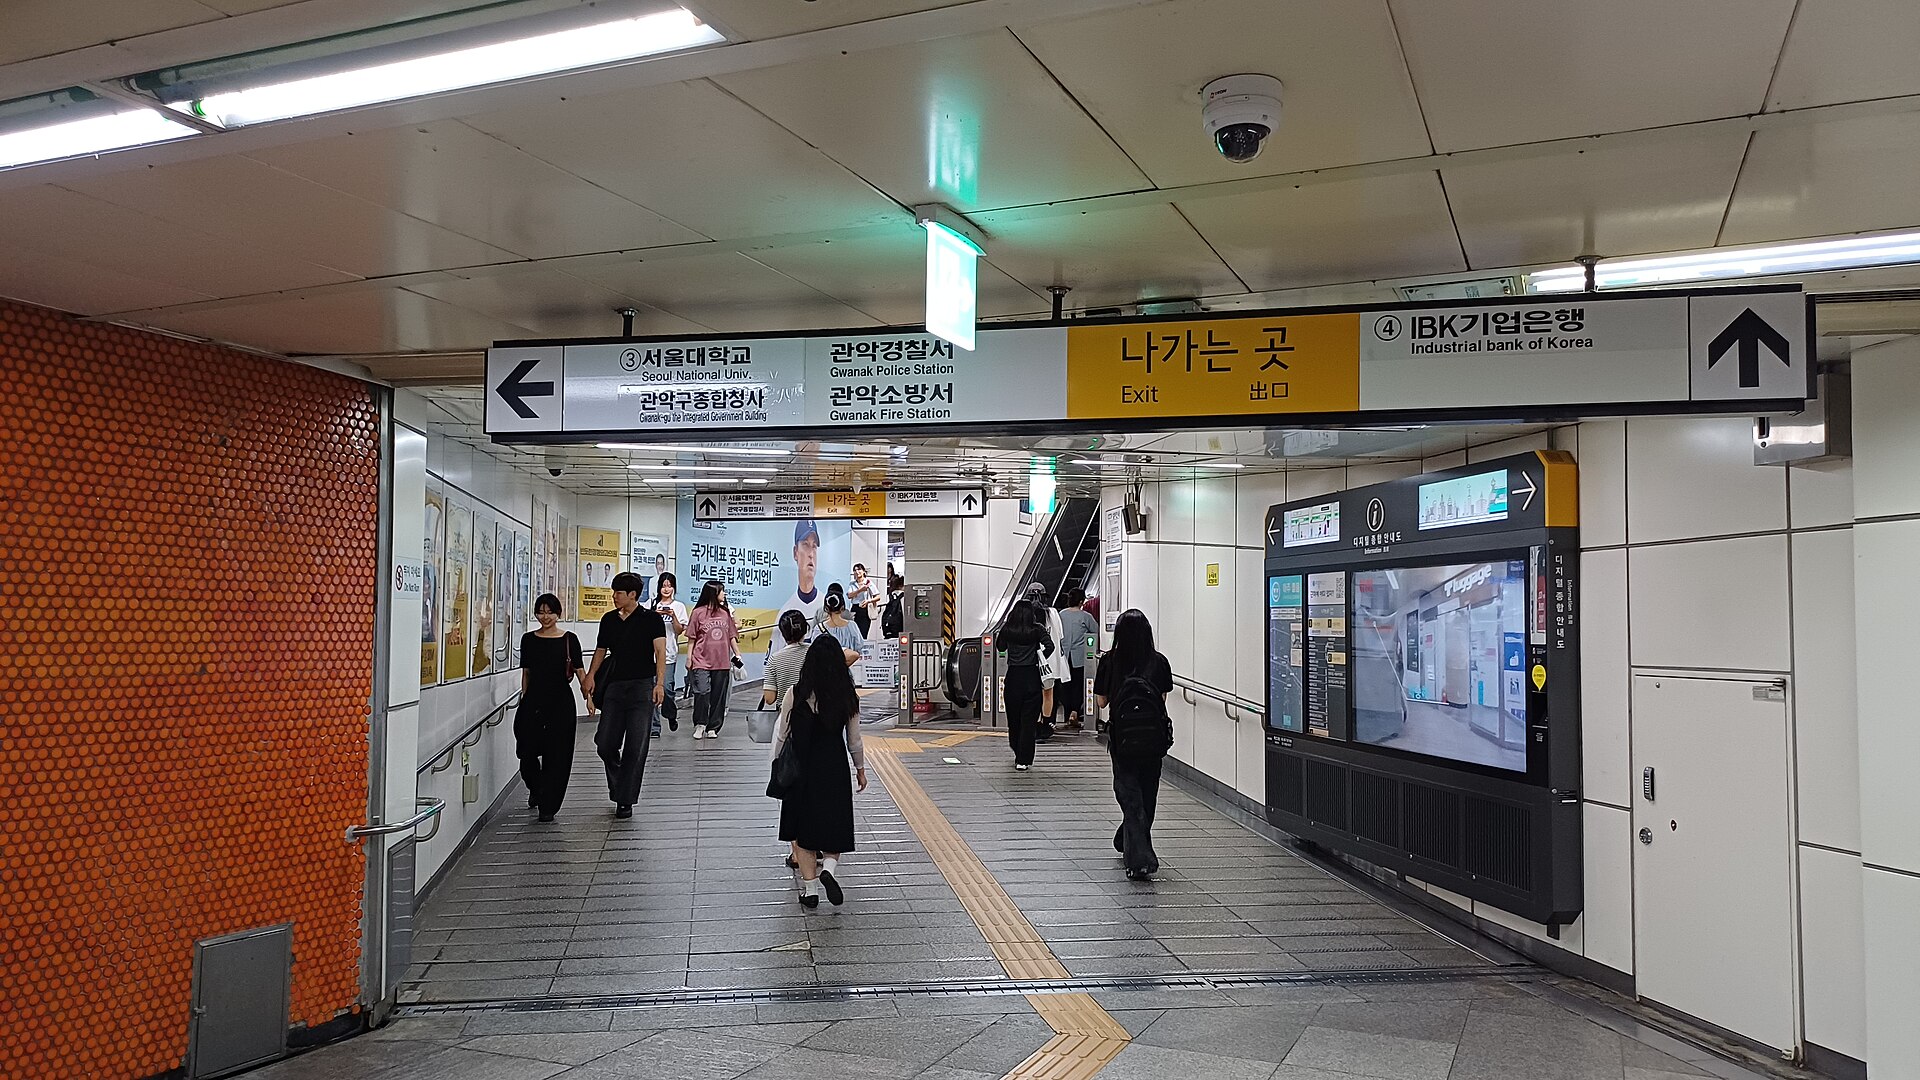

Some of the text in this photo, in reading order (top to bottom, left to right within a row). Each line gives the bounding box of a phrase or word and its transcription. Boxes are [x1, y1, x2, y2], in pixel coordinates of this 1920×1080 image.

[1411, 308, 1585, 339] IBK기업은행
[830, 339, 953, 363] 관악경찰서
[1121, 327, 1295, 373] 나가는 곳
[1411, 336, 1593, 355] Industrial bank of Korea
[641, 346, 752, 368] 서울대학교
[641, 368, 752, 382] Seoul National Univ.
[830, 363, 954, 378] Gwanak Police Station
[640, 389, 764, 411] 관악구종합청사
[829, 382, 953, 406] 관악소방서
[1121, 385, 1159, 404] Exit
[1249, 381, 1289, 401] 出口
[672, 412, 682, 422] the
[830, 407, 951, 421] Gwanak Fire Station
[827, 493, 871, 506] 나가는 곳
[897, 491, 938, 499] IBK기업은행
[775, 505, 810, 513] 관악소방서
[1383, 531, 1402, 544] 안내도
[690, 543, 779, 568] 국가대표 공식 매트리스
[690, 563, 772, 587] 베스트슬립 체인지업!
